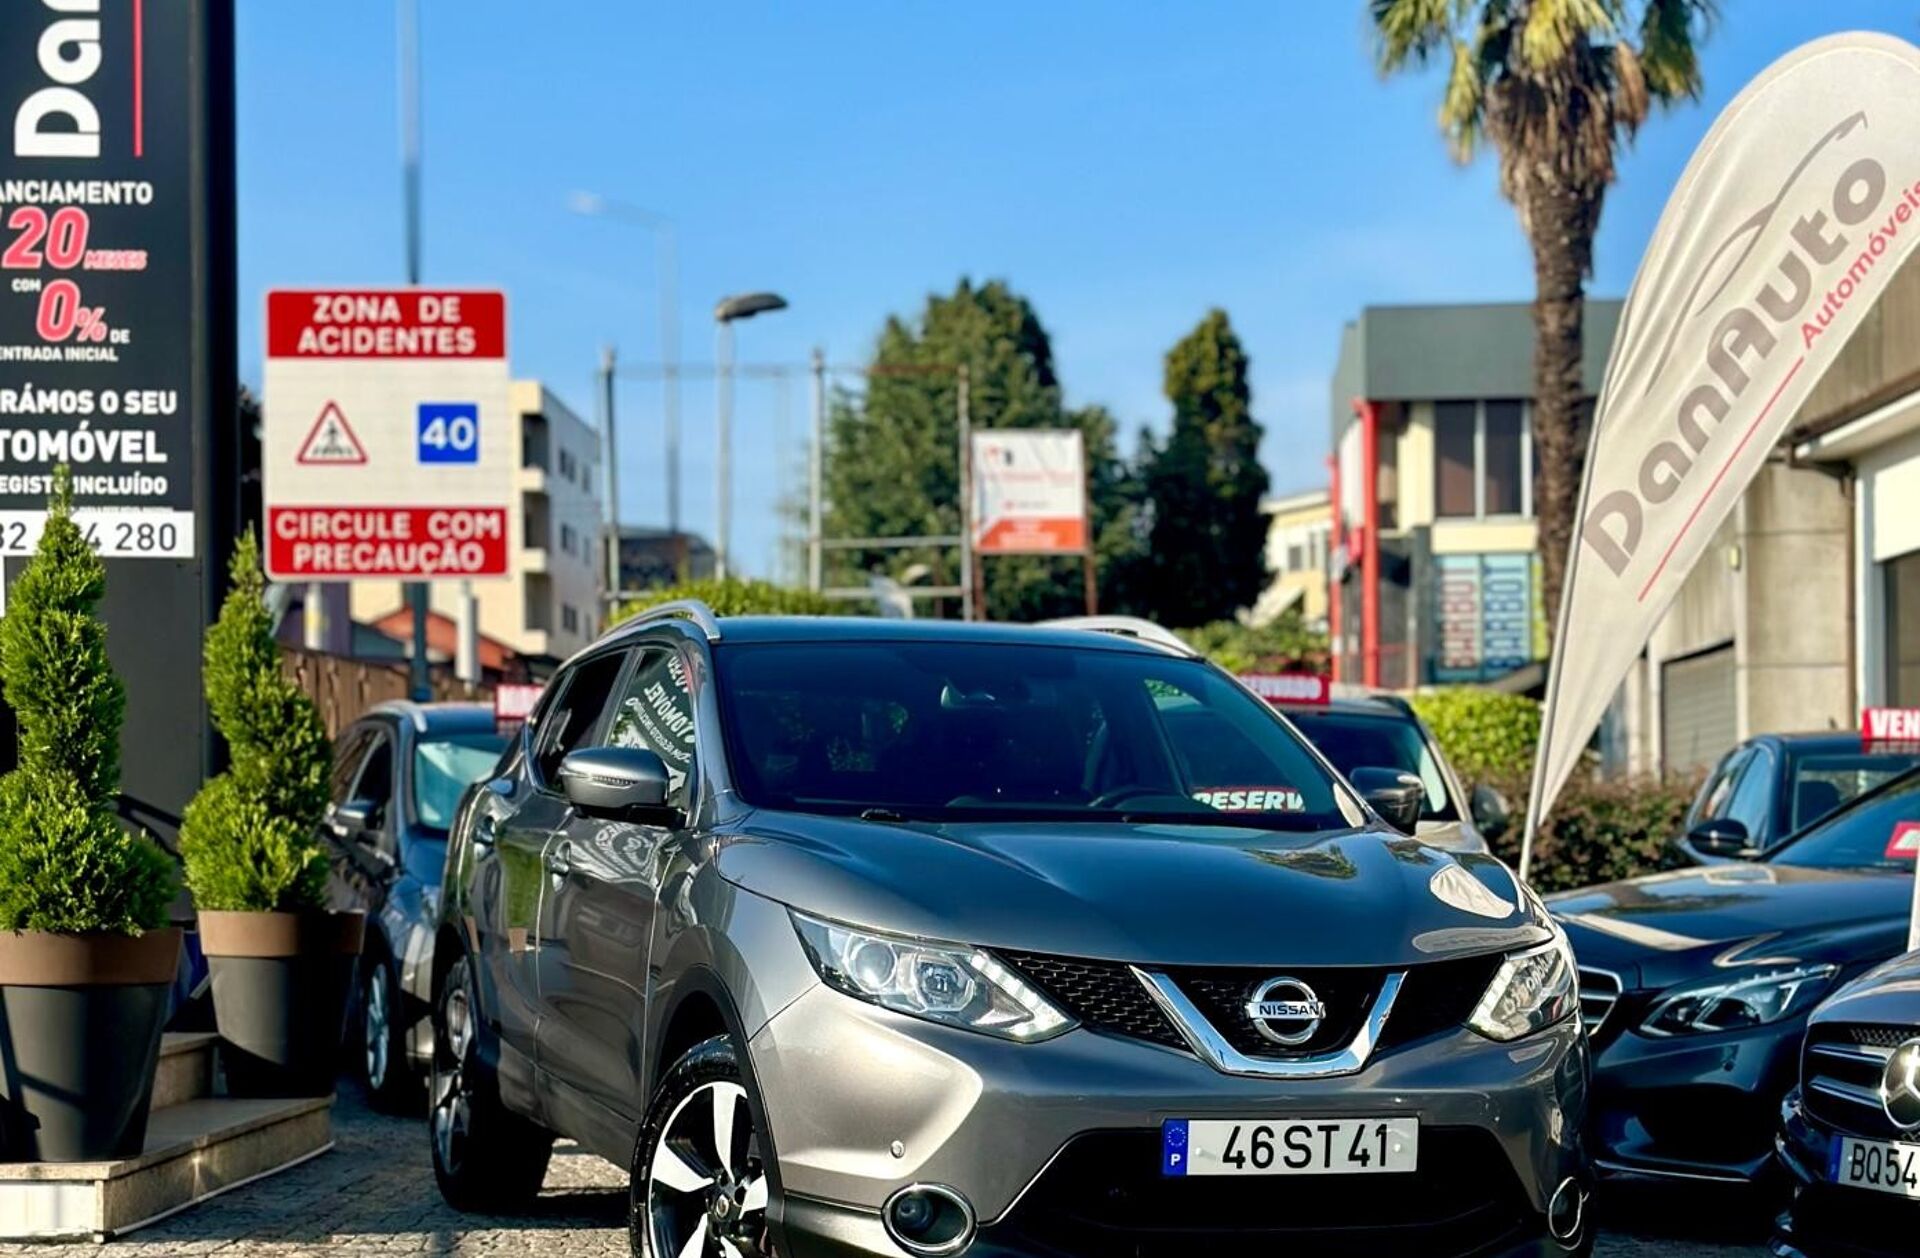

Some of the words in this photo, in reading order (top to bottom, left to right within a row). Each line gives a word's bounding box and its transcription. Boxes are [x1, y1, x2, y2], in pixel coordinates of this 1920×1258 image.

[15, 0, 102, 157] Da
[0, 206, 90, 270] 20
[11, 279, 41, 292] COM
[110, 329, 131, 344] DE
[313, 296, 401, 323] ZONA
[418, 296, 461, 323] DE
[298, 327, 477, 354] ACIDENTES
[65, 347, 119, 362] INICIAL
[1582, 157, 1887, 579] DanAuto
[100, 389, 119, 414] O
[124, 390, 177, 415] SEU
[420, 416, 477, 451] 40
[72, 471, 168, 495] INCLUÍDO
[0, 521, 27, 551] 2
[115, 522, 176, 551] 280
[275, 512, 412, 539] CIRCULE
[427, 512, 502, 539] COM
[292, 540, 486, 574] PRECAUÇÃO
[1871, 709, 1920, 738] VEN
[1192, 791, 1305, 811] ESERV
[1259, 1004, 1319, 1016] NISSAN
[1170, 1154, 1181, 1167] P
